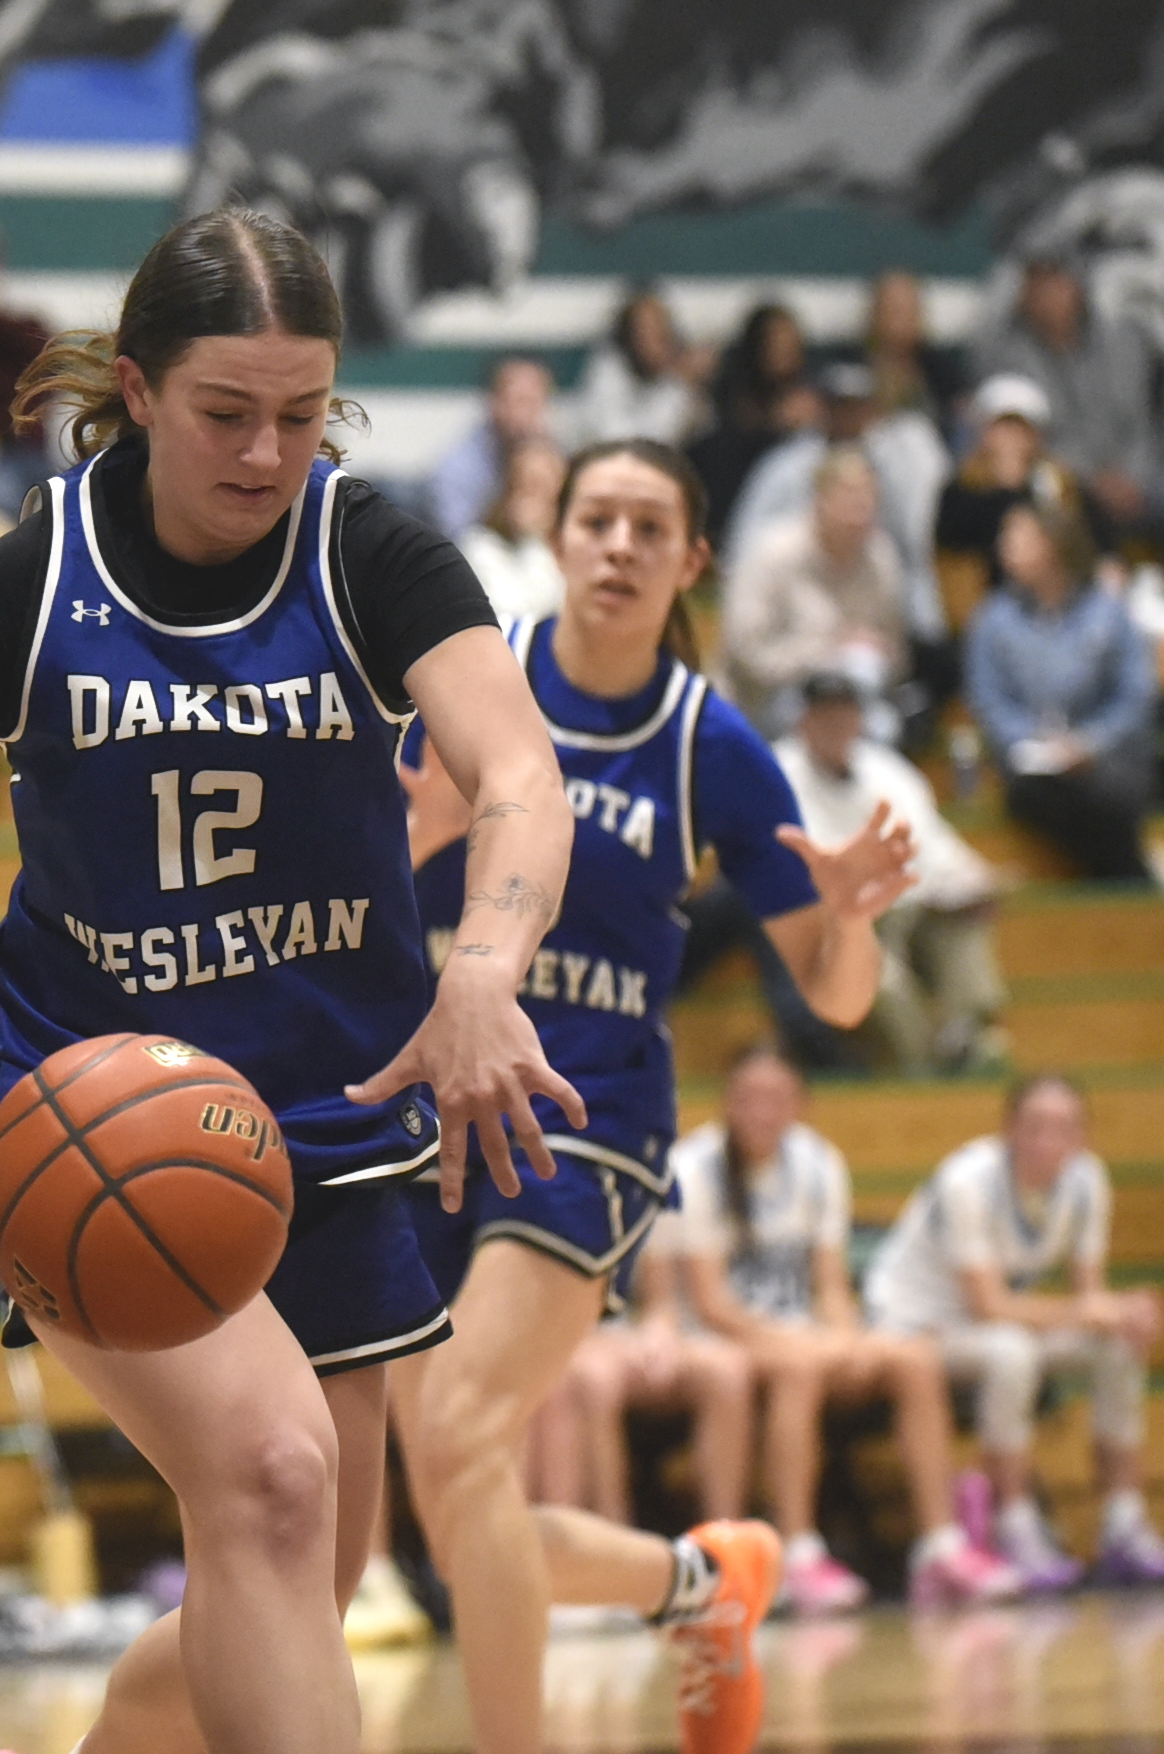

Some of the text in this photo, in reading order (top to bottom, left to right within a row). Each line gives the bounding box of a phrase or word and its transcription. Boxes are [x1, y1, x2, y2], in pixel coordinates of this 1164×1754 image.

[67, 671, 356, 750] DAKOTA
[151, 769, 264, 891] 12
[565, 778, 656, 860] OTA
